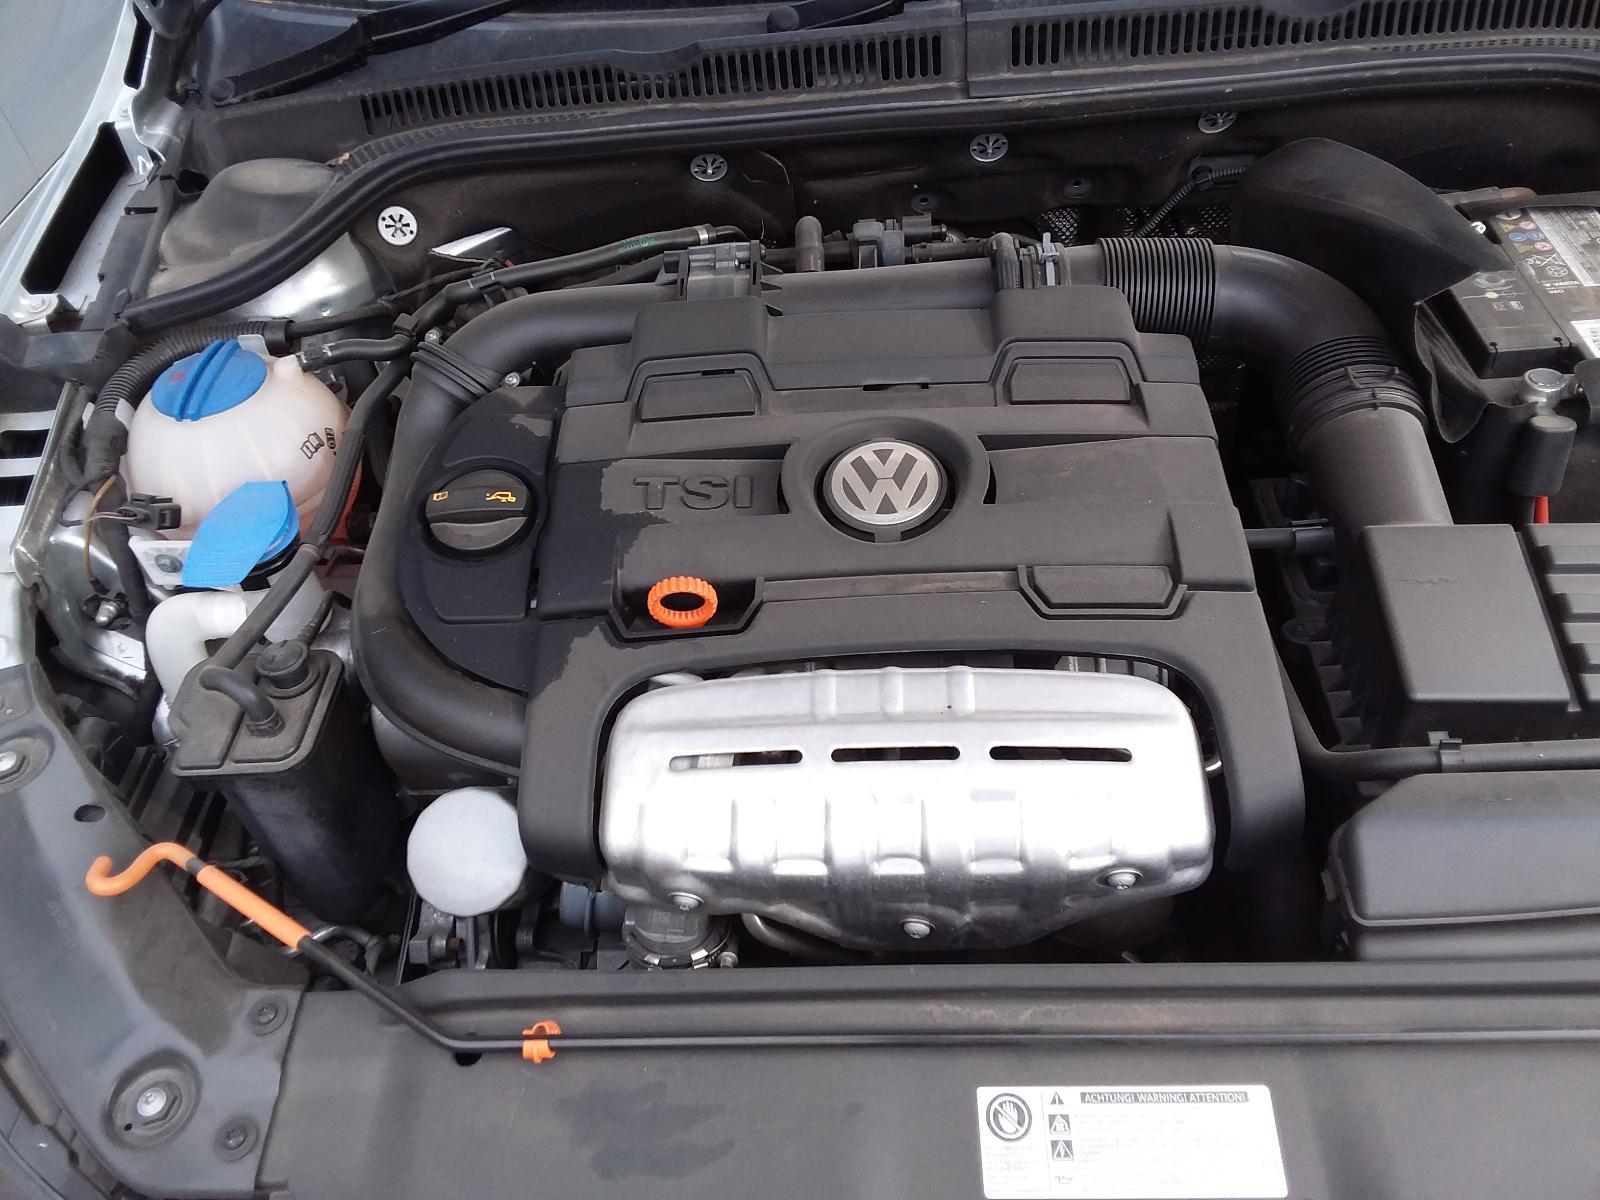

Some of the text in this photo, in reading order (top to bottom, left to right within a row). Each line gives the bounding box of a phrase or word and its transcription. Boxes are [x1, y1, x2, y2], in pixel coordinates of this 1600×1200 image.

[633, 474, 753, 511] TSI
[1084, 1091, 1246, 1103] ACHTUNG! WARNING! ATTENTION!
